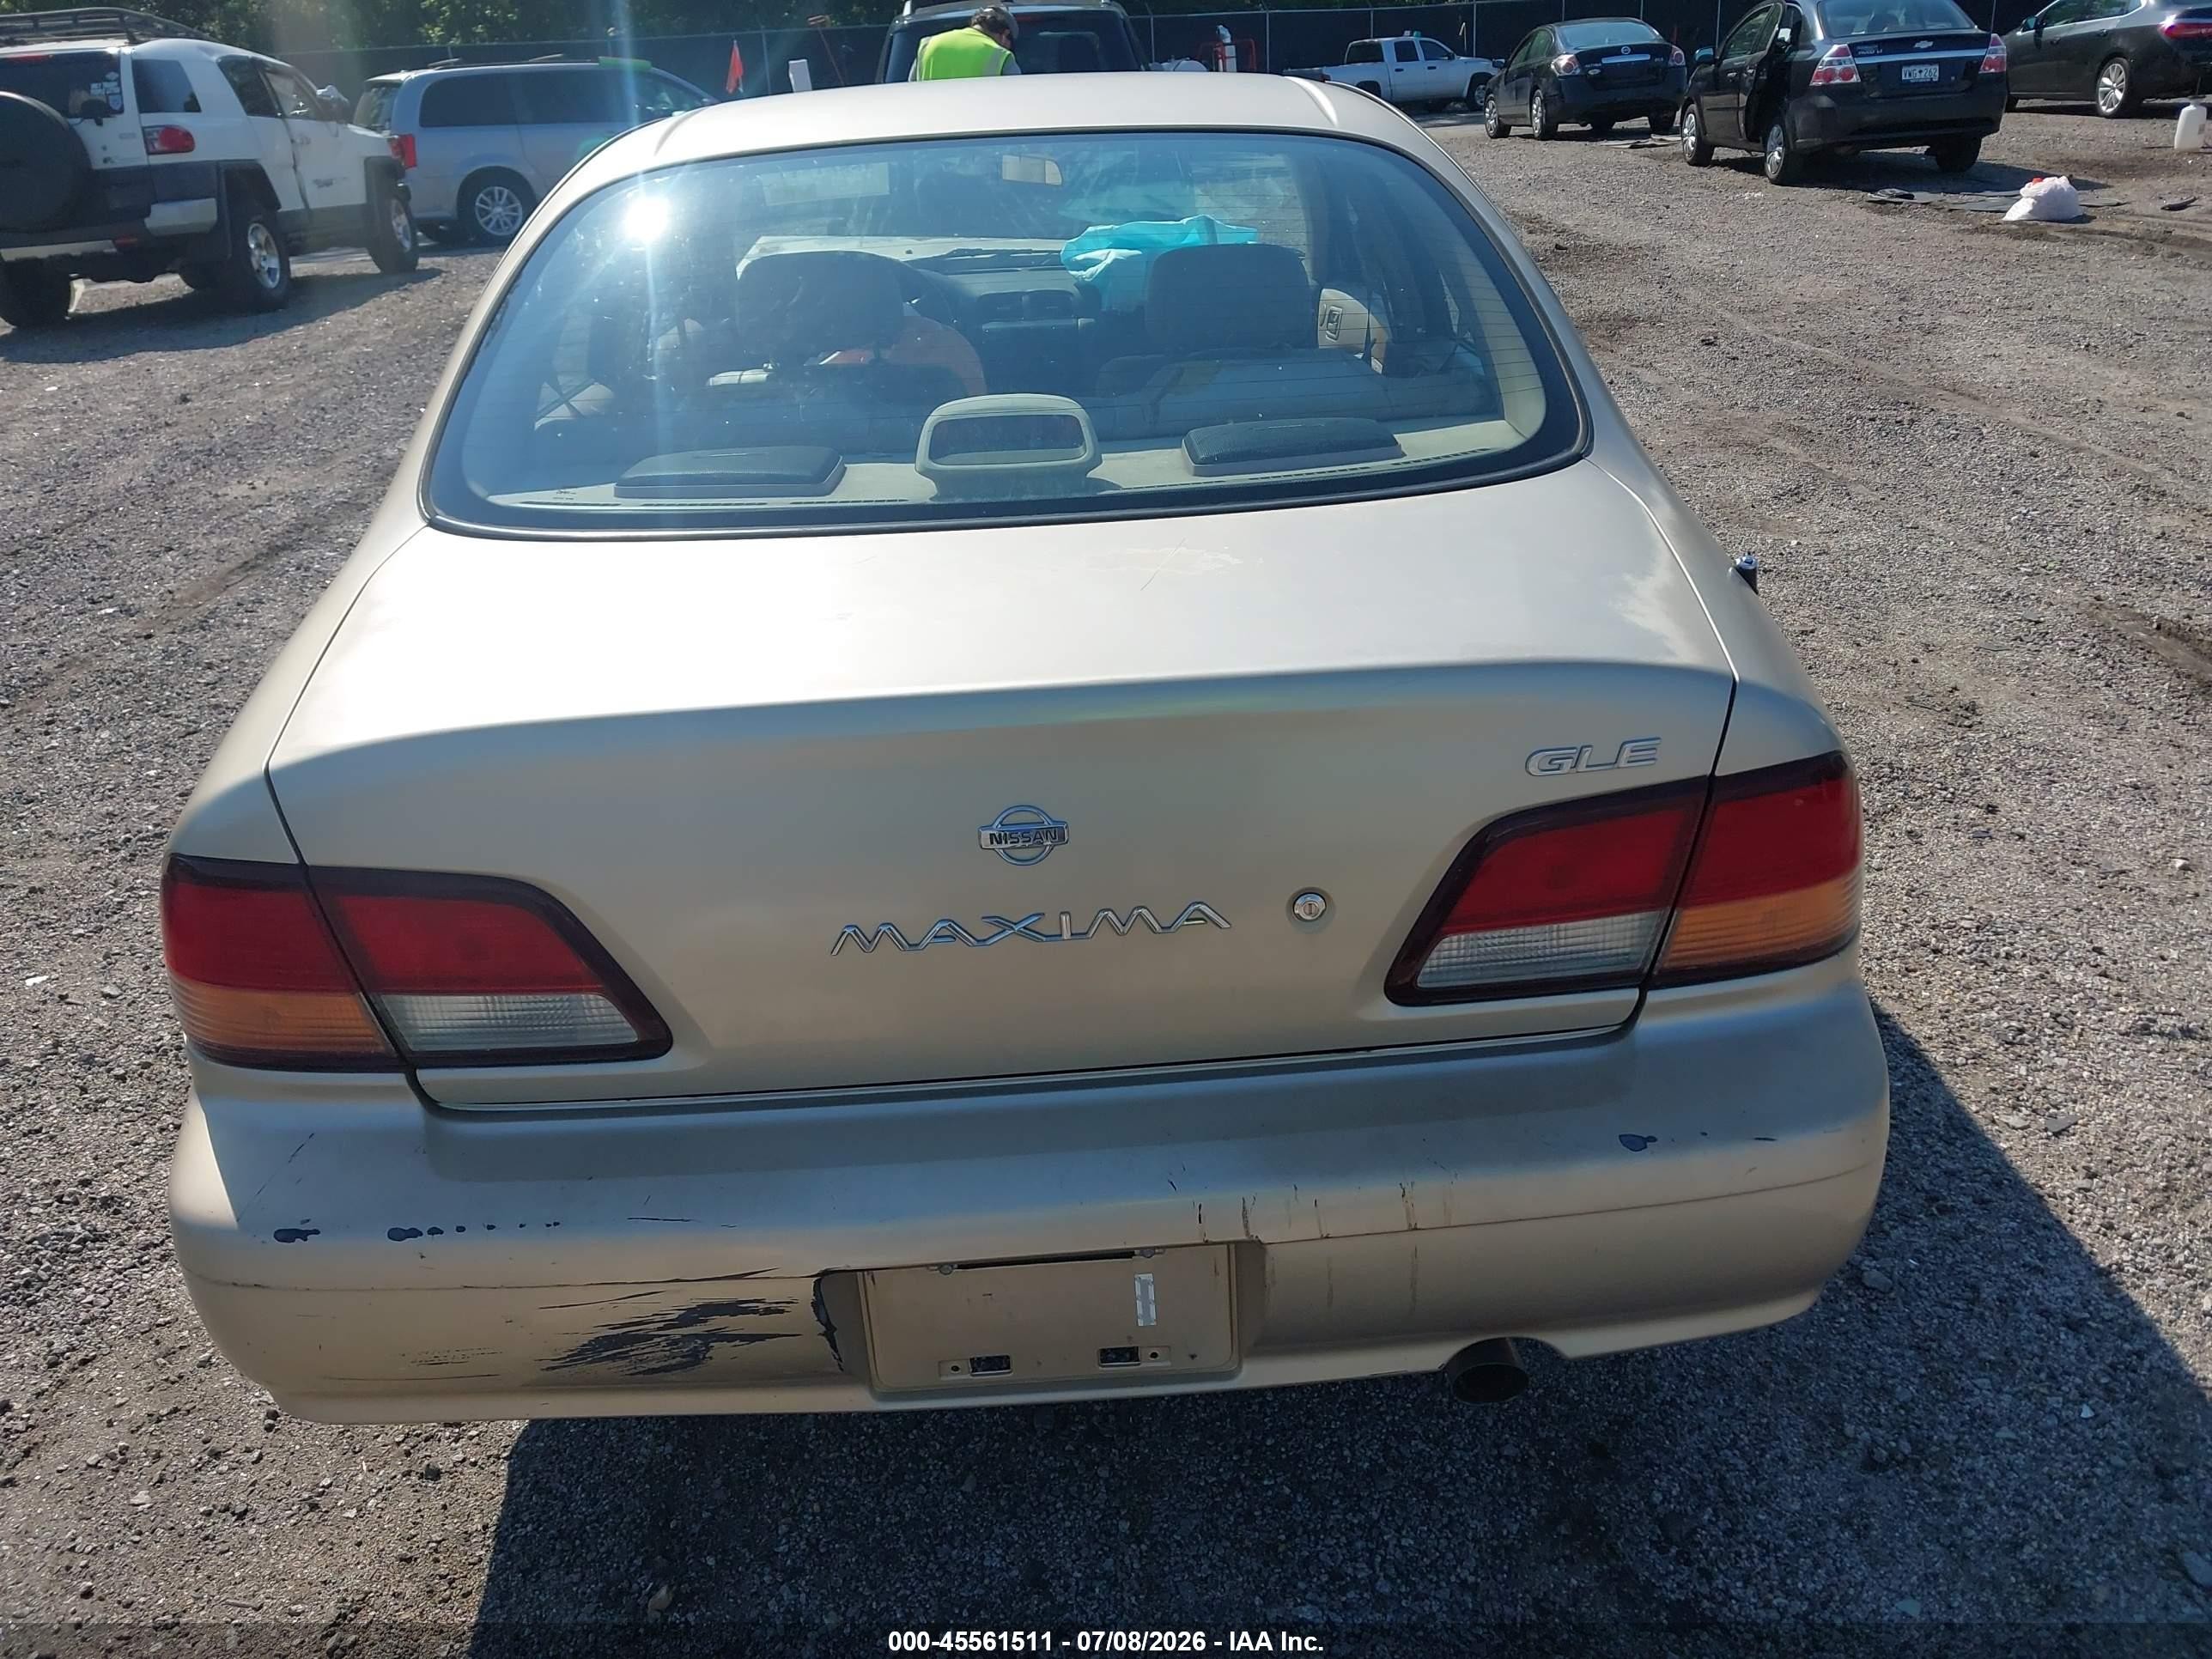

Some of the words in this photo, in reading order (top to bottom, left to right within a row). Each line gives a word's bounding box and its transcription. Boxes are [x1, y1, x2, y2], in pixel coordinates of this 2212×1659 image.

[1525, 737, 1662, 776] GLE
[988, 829, 1058, 845] NISSAN
[830, 901, 1232, 956] MAXIMA
